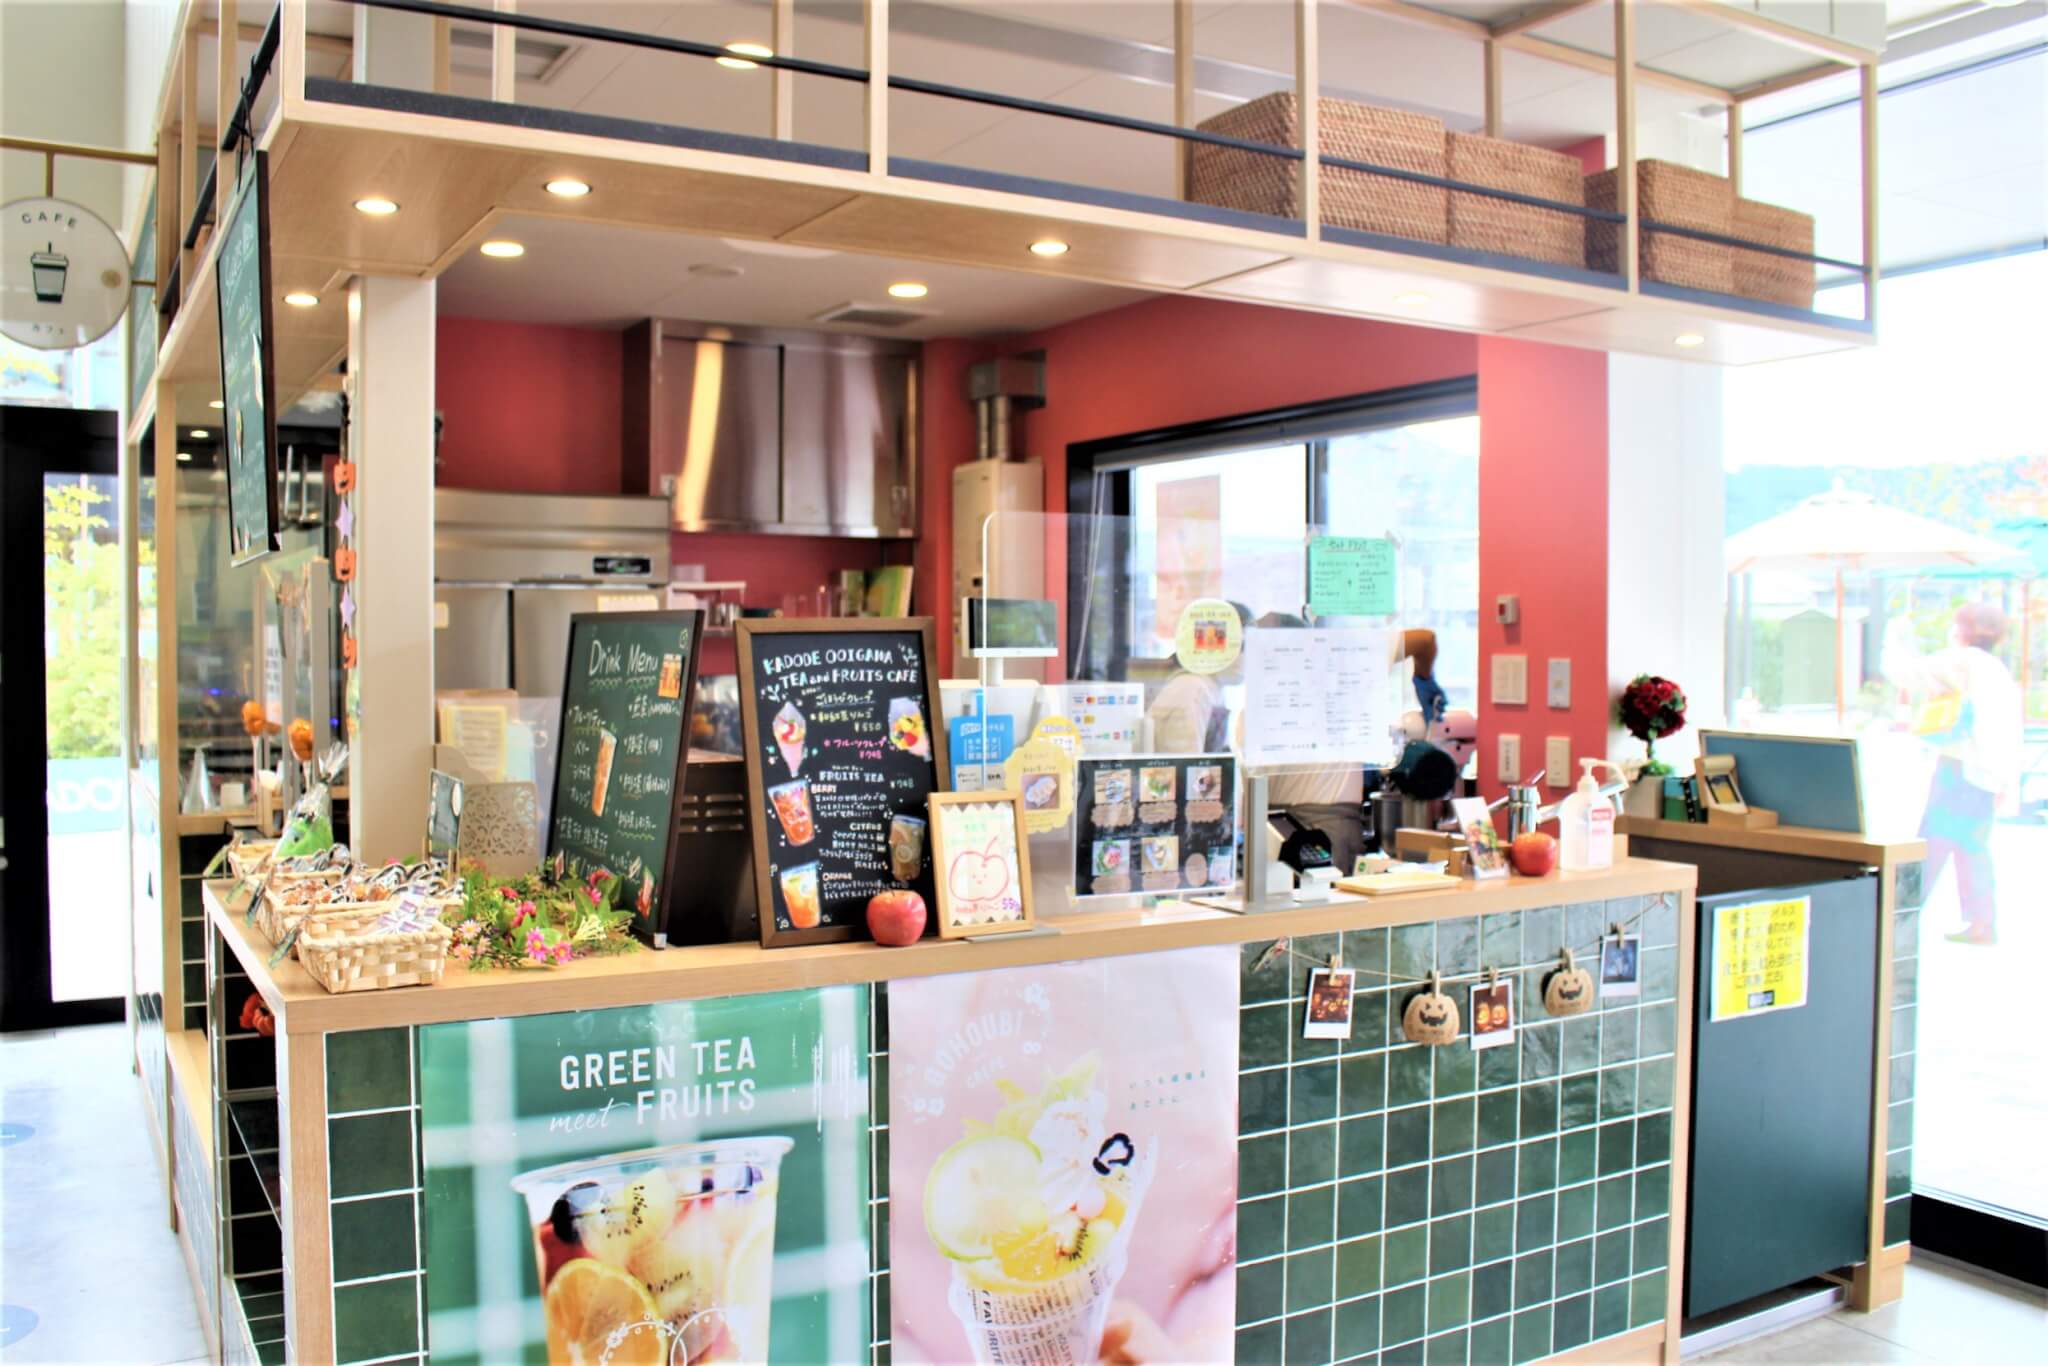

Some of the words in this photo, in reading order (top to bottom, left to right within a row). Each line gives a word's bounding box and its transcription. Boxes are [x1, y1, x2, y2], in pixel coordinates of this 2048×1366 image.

[21, 210, 78, 229] CAFE
[588, 640, 622, 676] Drink
[627, 643, 659, 675] Menu
[763, 650, 822, 675] KADODE
[778, 672, 809, 689] TEA
[810, 673, 830, 685] and
[832, 669, 883, 684] FRUITS
[887, 669, 918, 683] CAFE
[819, 771, 860, 782] FRUITS
[864, 773, 885, 783] TEA
[811, 784, 838, 794] BERRY
[560, 1045, 677, 1091] GREEN
[691, 1036, 757, 1077] TEA
[549, 1096, 631, 1134] meet
[635, 1078, 757, 1125] FRUITS
